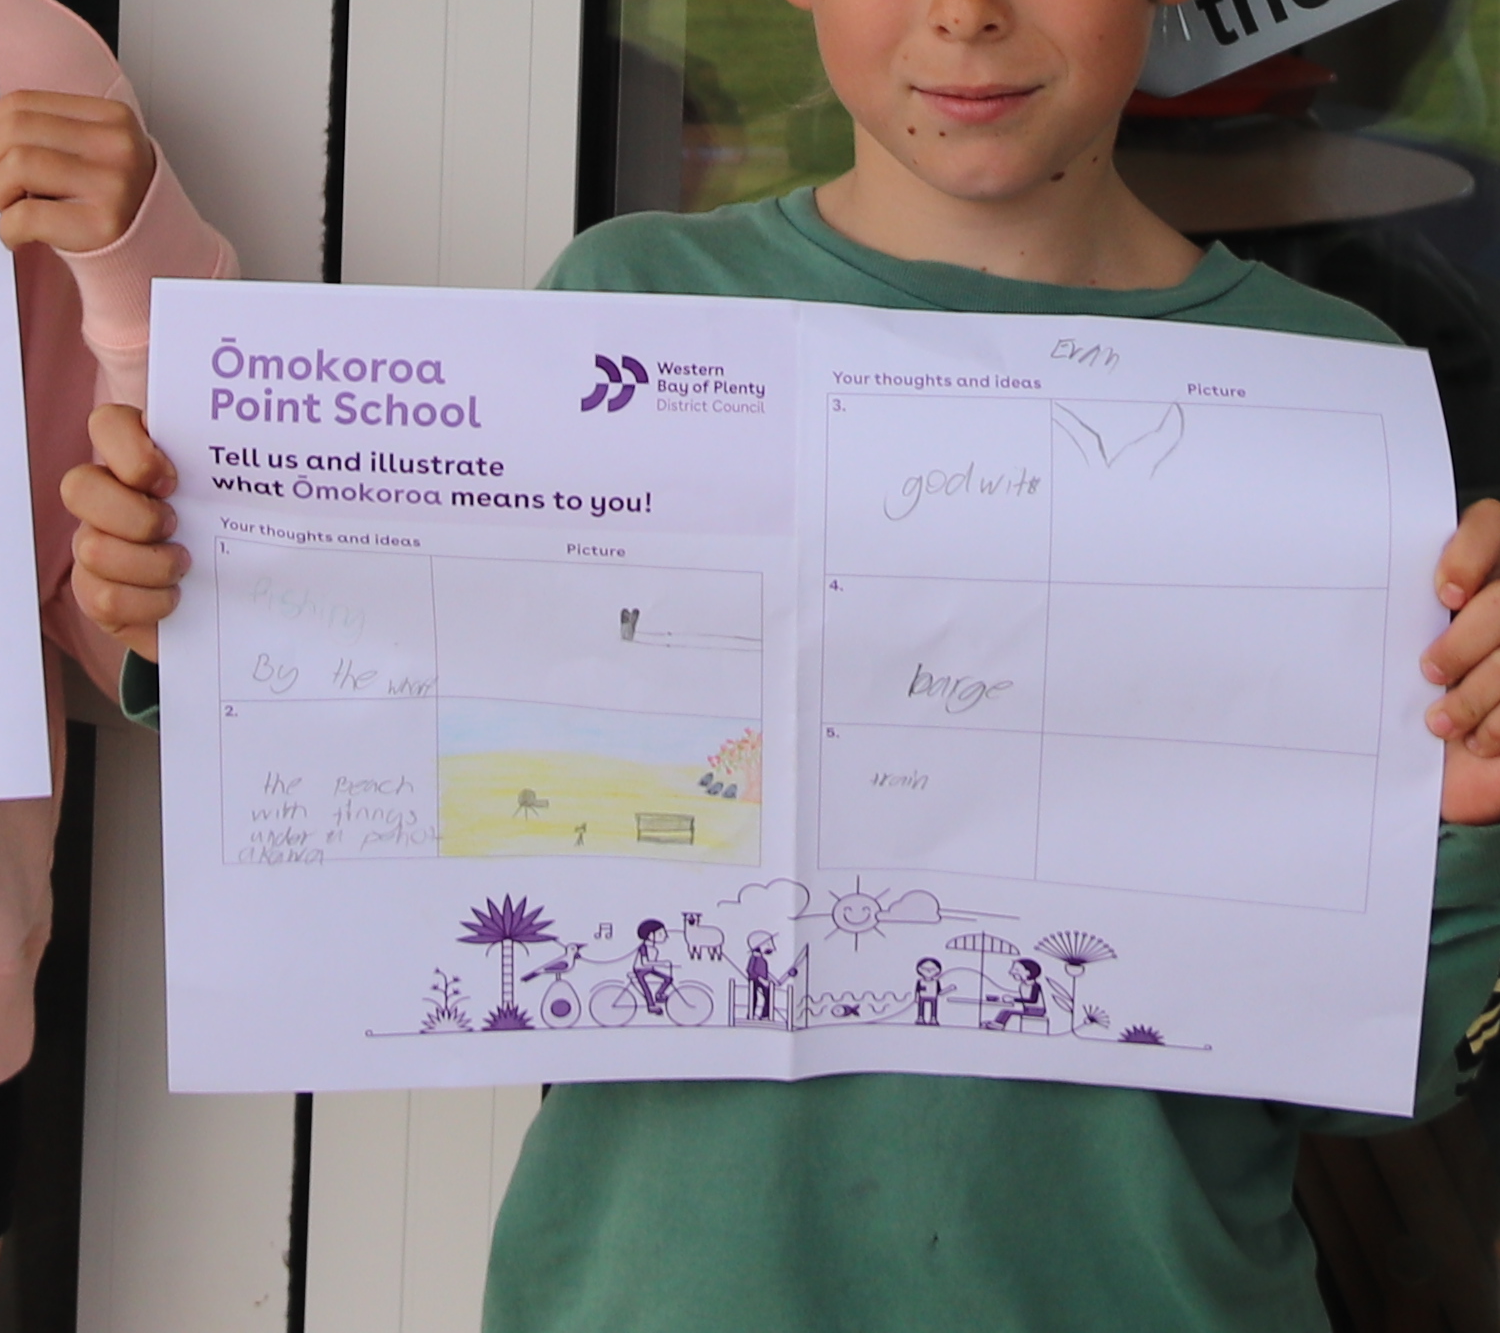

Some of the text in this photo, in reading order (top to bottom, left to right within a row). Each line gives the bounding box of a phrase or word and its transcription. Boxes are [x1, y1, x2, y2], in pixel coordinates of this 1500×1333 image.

[212, 337, 445, 385] Ōmokoroa
[657, 361, 725, 377] Western
[657, 379, 765, 398] Bay of Plenty
[832, 370, 1042, 390] Your thoughts and ideas
[1187, 382, 1246, 399] Picture
[210, 388, 481, 428] Point School
[657, 399, 765, 415] District Council
[832, 399, 846, 412] 3.
[209, 446, 504, 476] Tell us and illustrate
[212, 475, 653, 517] what Ōmokoroa means to you!
[220, 517, 421, 549] Your thoughts and ideas
[220, 542, 231, 555] 1.
[567, 544, 626, 558] Picture
[829, 579, 844, 592] 4.
[252, 652, 300, 693] By
[333, 657, 378, 692] the
[909, 662, 1014, 713] barge
[224, 705, 238, 718] 2.
[826, 726, 840, 738] 5.
[263, 772, 302, 795] the
[251, 803, 309, 823] with
